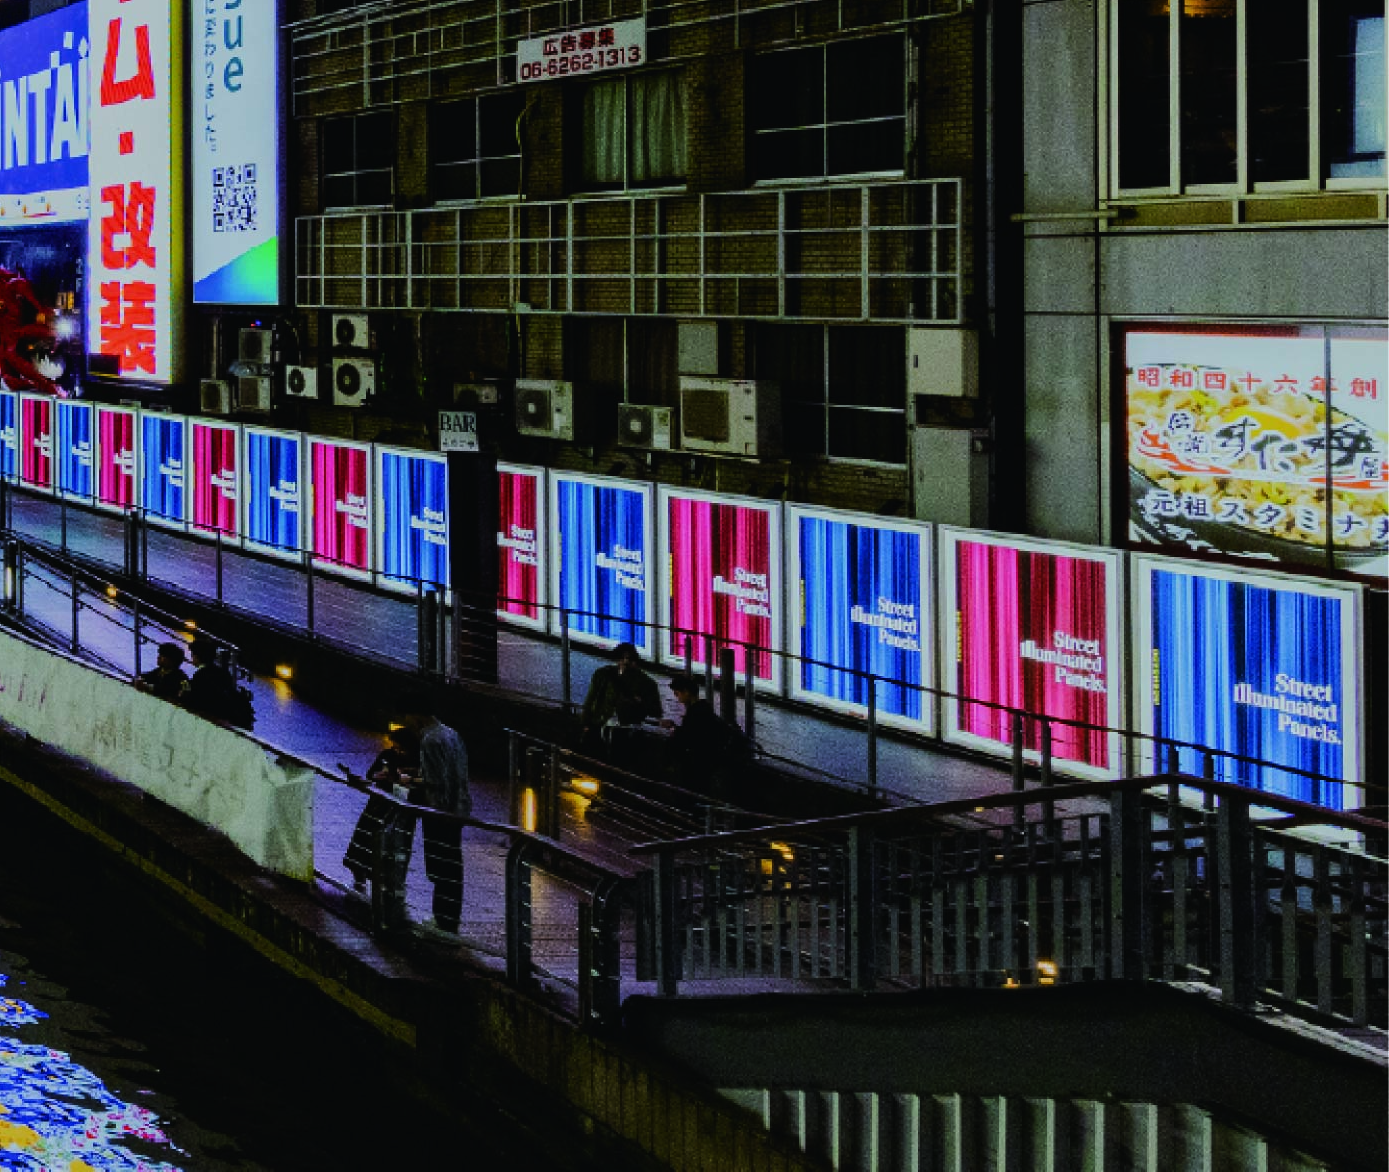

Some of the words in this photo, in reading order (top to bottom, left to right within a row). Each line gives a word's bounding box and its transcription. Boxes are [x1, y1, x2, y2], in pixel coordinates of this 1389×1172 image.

[521, 43, 642, 80] 06-6262-1313
[1138, 367, 1377, 400] 昭和四十六年創
[440, 413, 476, 434] BAR
[1020, 638, 1103, 675] Illuminated
[1053, 630, 1101, 657] Street
[1055, 666, 1107, 694] Panels.
[1275, 672, 1333, 703] Street
[1233, 682, 1338, 724] Illuminated
[1277, 712, 1342, 746] Panels.
